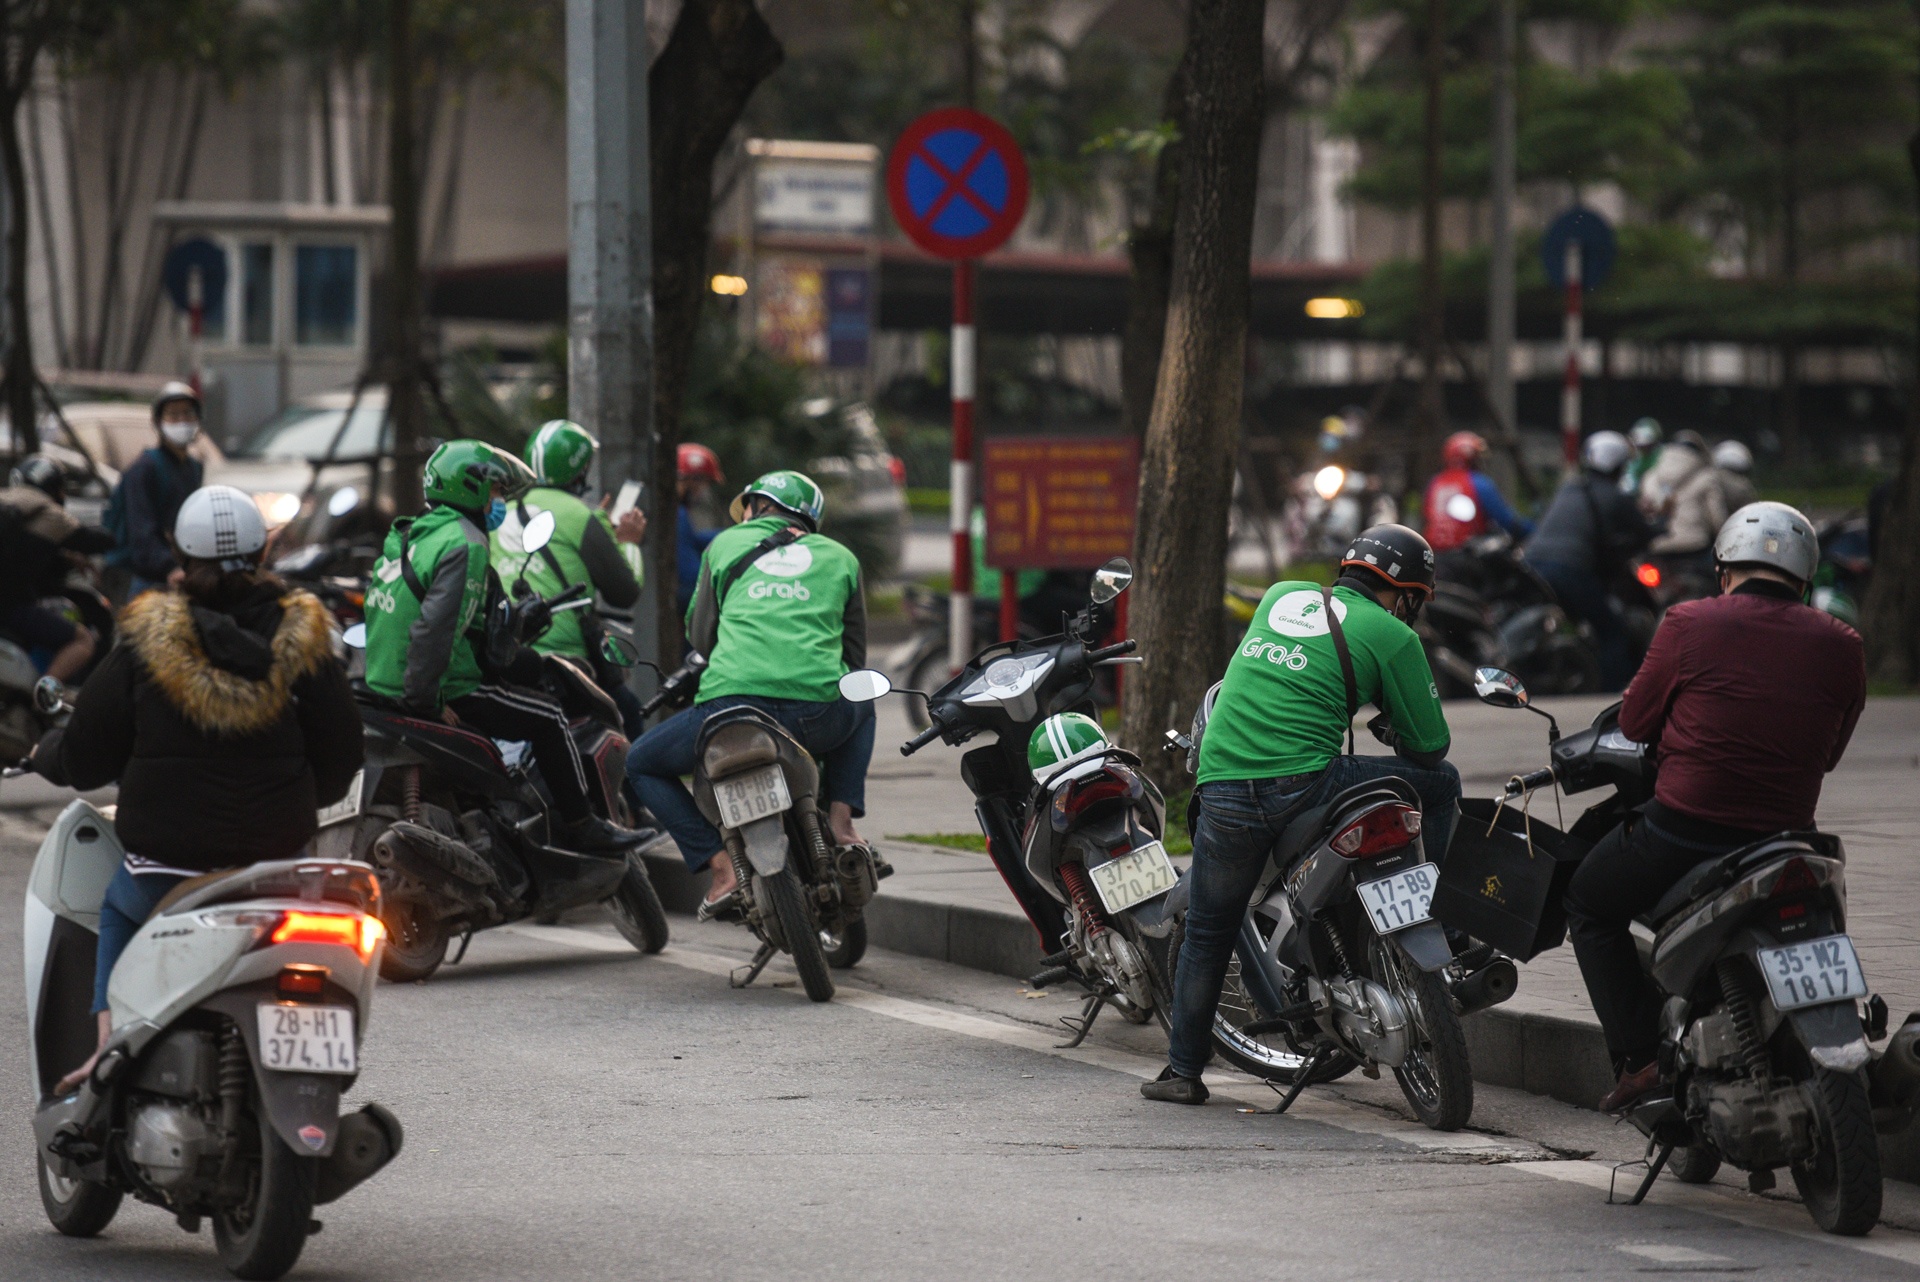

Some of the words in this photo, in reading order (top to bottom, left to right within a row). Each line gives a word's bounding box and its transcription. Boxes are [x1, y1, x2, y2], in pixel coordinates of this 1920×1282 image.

[748, 580, 810, 601] Grab
[1278, 615, 1315, 631] GrabBike
[1241, 637, 1308, 671] Grab
[1078, 773, 1105, 785] HONDA
[729, 791, 780, 822] 8108
[1101, 848, 1157, 886] 37-P1
[1376, 855, 1402, 867] HONDA
[1107, 866, 1170, 908] 170.27
[1371, 870, 1432, 904] 17-B9
[1773, 941, 1846, 975] 35-M2
[1784, 967, 1848, 1003] 1817
[274, 1008, 341, 1037] 28-H1
[267, 1039, 350, 1068] 374.14
